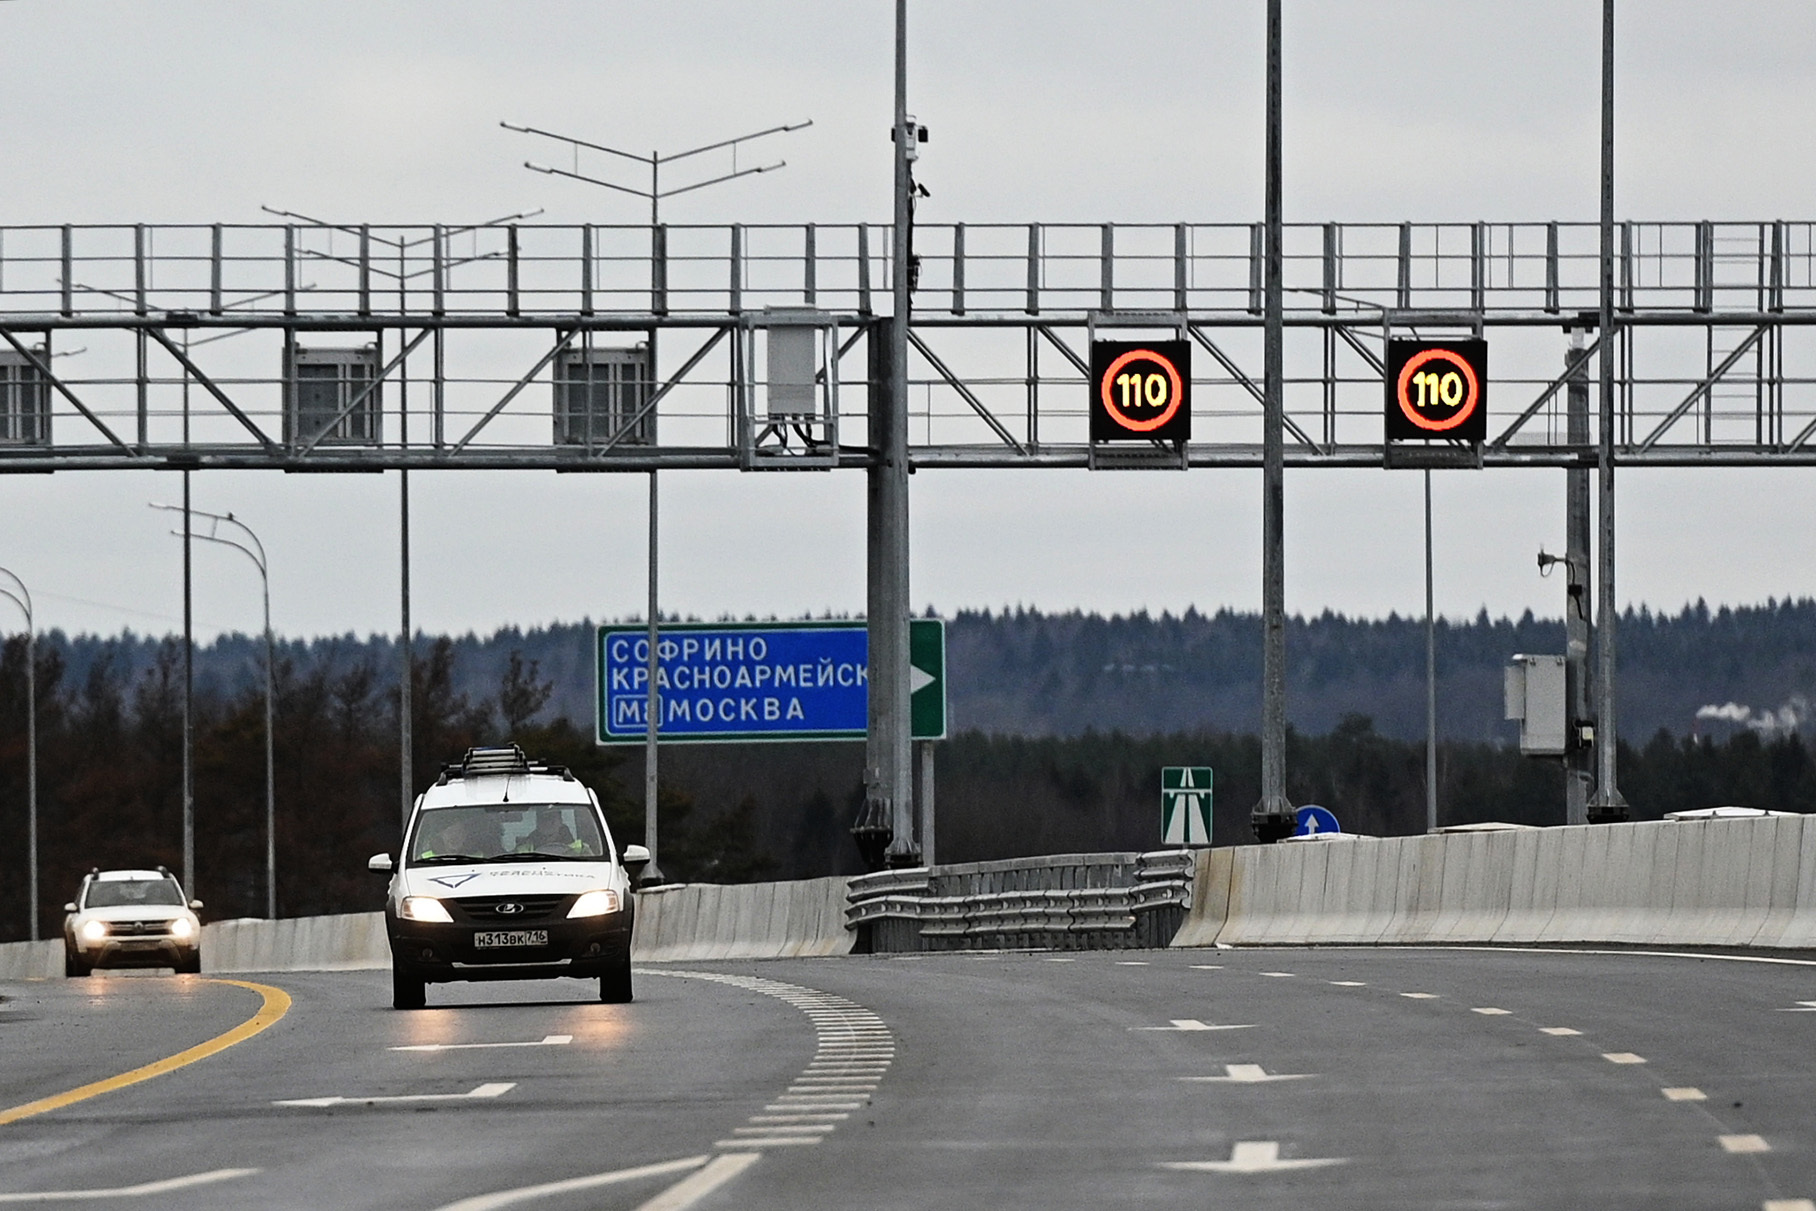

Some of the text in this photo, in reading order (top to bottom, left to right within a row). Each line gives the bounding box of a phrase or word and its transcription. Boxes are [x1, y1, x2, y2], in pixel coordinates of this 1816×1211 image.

[1116, 373, 1168, 408] 110
[1413, 371, 1464, 407] 110
[612, 638, 767, 663] СОФРИНО
[612, 657, 869, 690] КРАСНОАРМЕЙСК
[619, 698, 805, 722] М МОСКВА
[526, 930, 547, 941] 716
